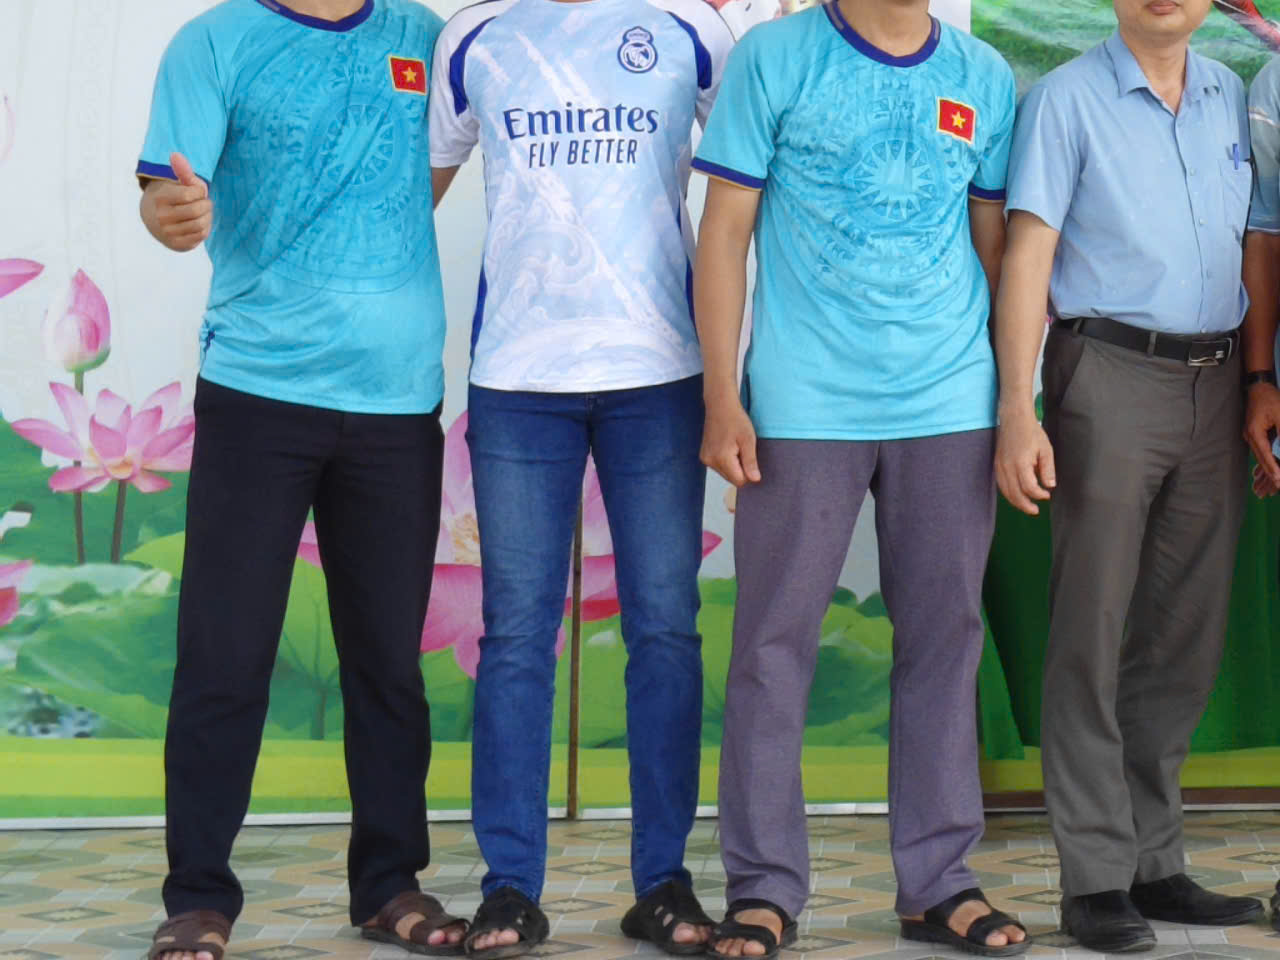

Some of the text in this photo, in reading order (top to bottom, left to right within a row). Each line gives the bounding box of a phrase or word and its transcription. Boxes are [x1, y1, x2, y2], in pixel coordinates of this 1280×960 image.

[503, 102, 660, 141] Emirates
[528, 139, 638, 168] FLY BETTER
